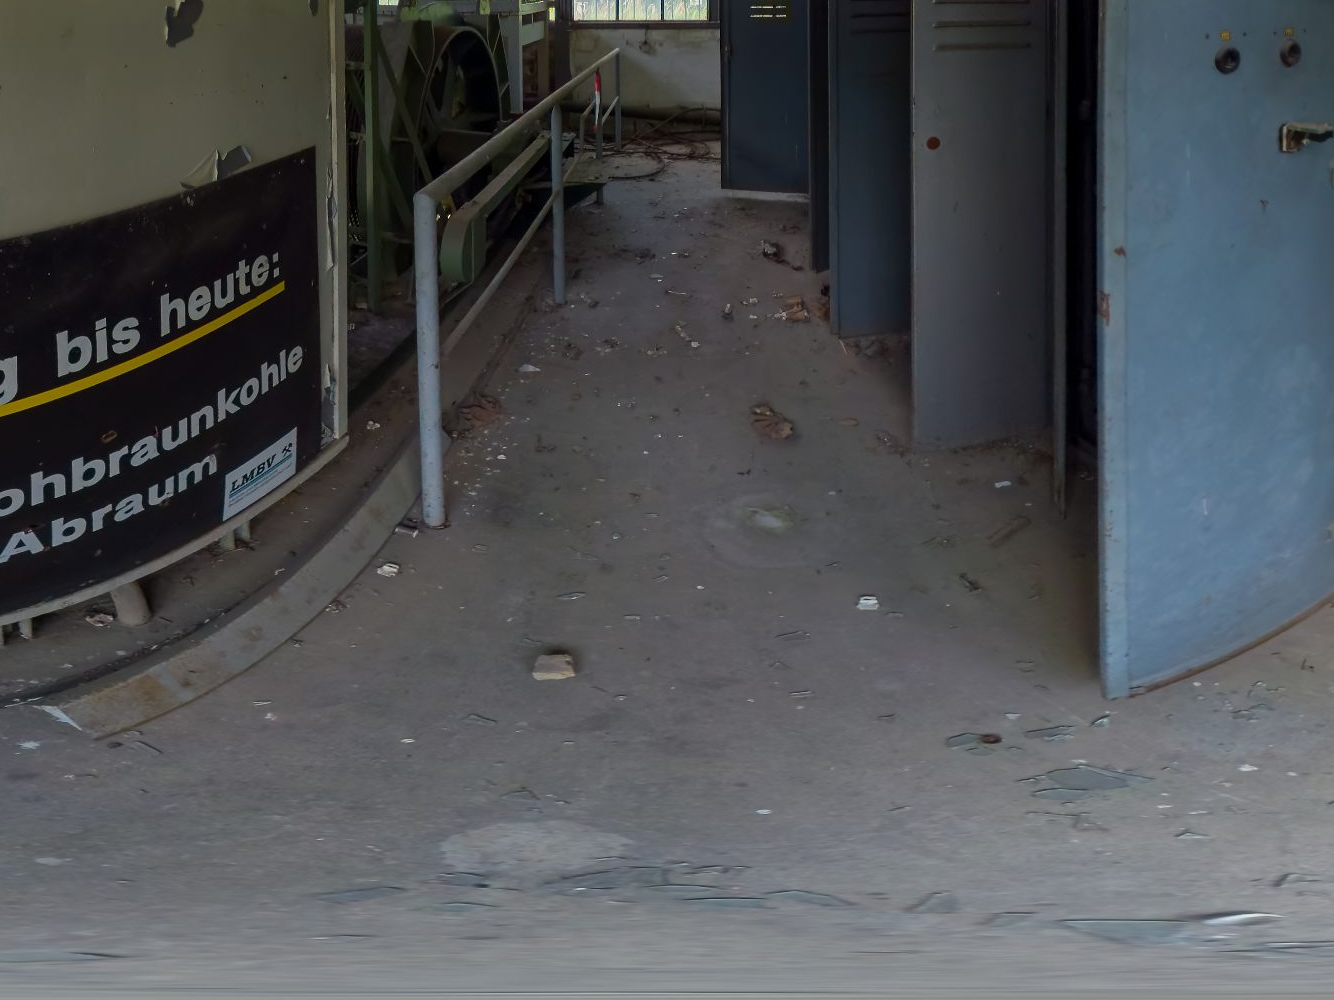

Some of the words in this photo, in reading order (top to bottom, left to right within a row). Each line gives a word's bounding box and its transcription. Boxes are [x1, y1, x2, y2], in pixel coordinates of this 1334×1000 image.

[56, 317, 142, 378] bis
[160, 251, 281, 338] heute:
[229, 453, 277, 494] LMBV
